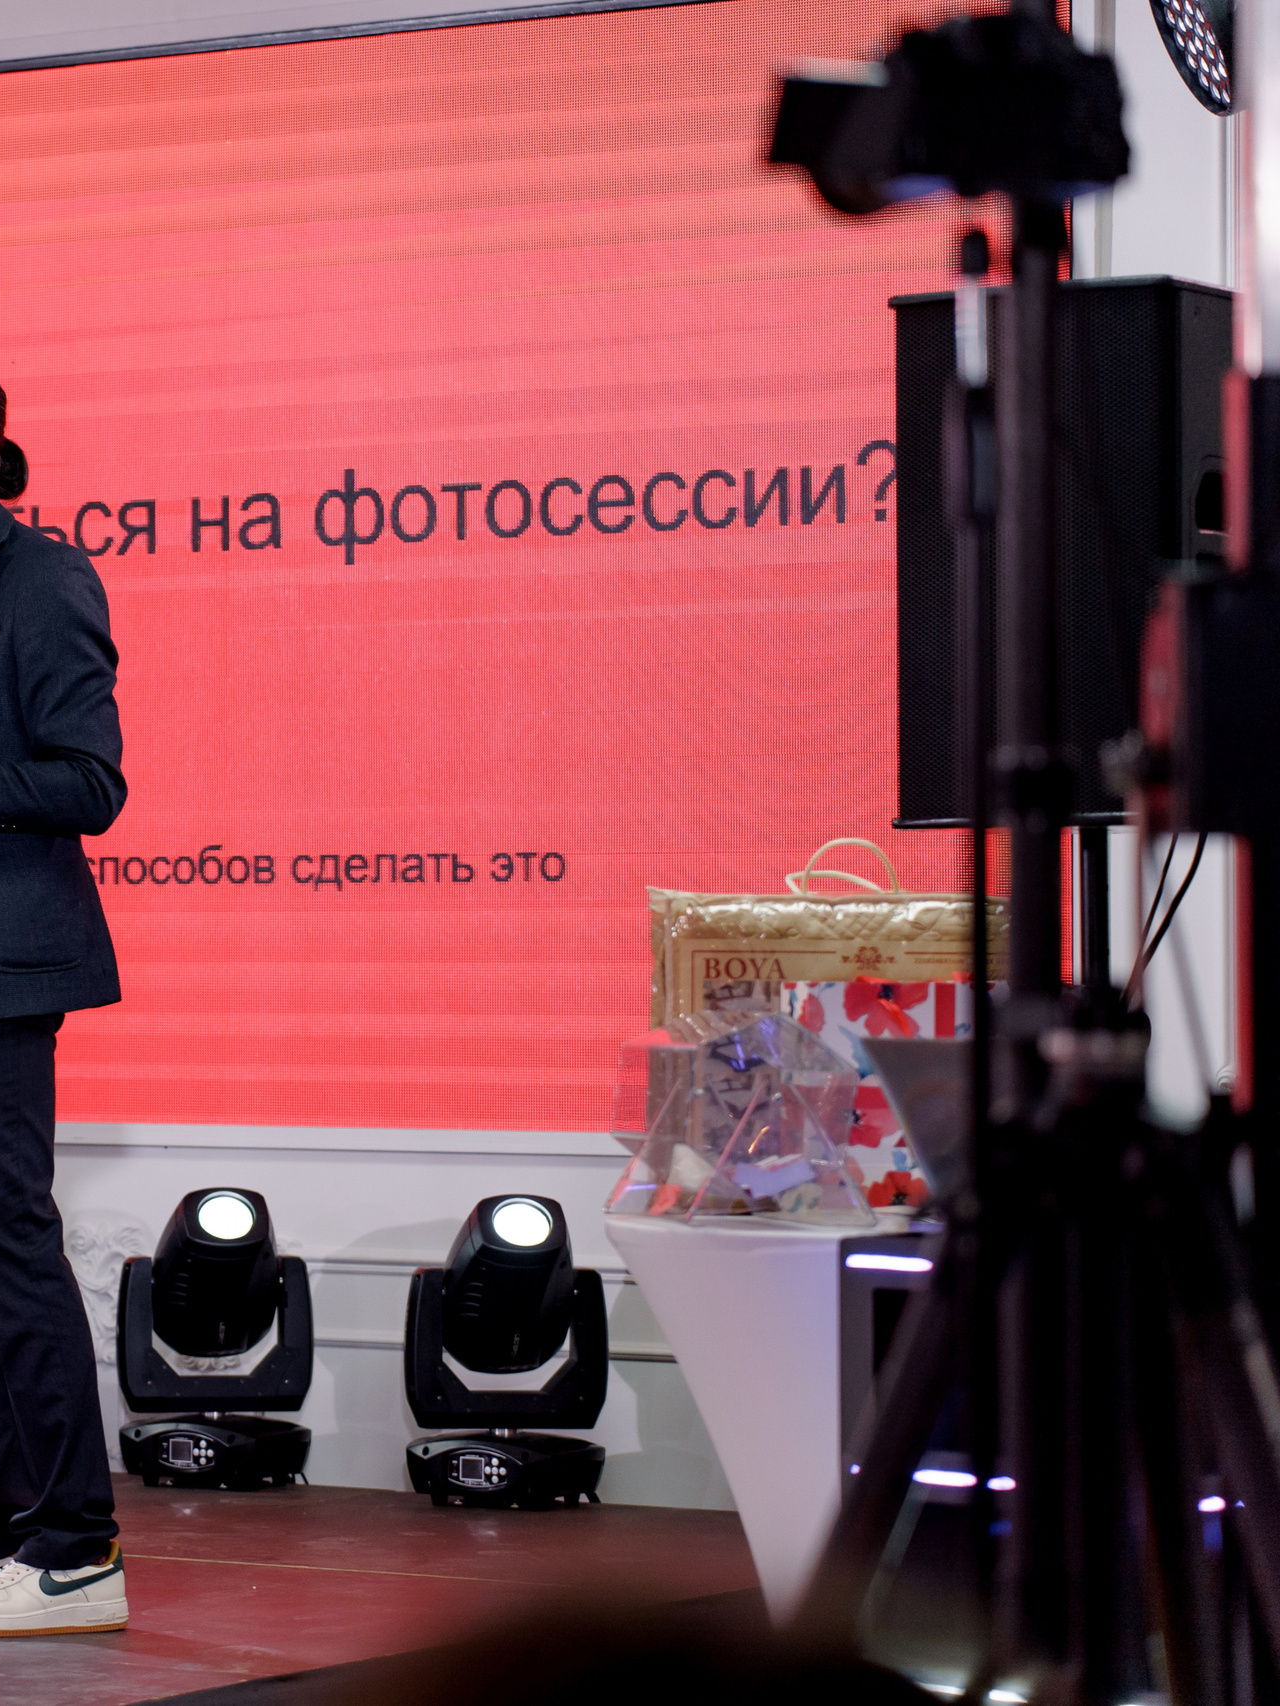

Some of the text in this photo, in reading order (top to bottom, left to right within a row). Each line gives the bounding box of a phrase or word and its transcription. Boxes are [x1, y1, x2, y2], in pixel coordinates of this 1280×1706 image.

[191, 492, 283, 553] на
[315, 440, 897, 565] фотосессии?
[292, 853, 474, 891] сделать
[491, 852, 566, 882] это
[703, 957, 787, 980] BOYA
